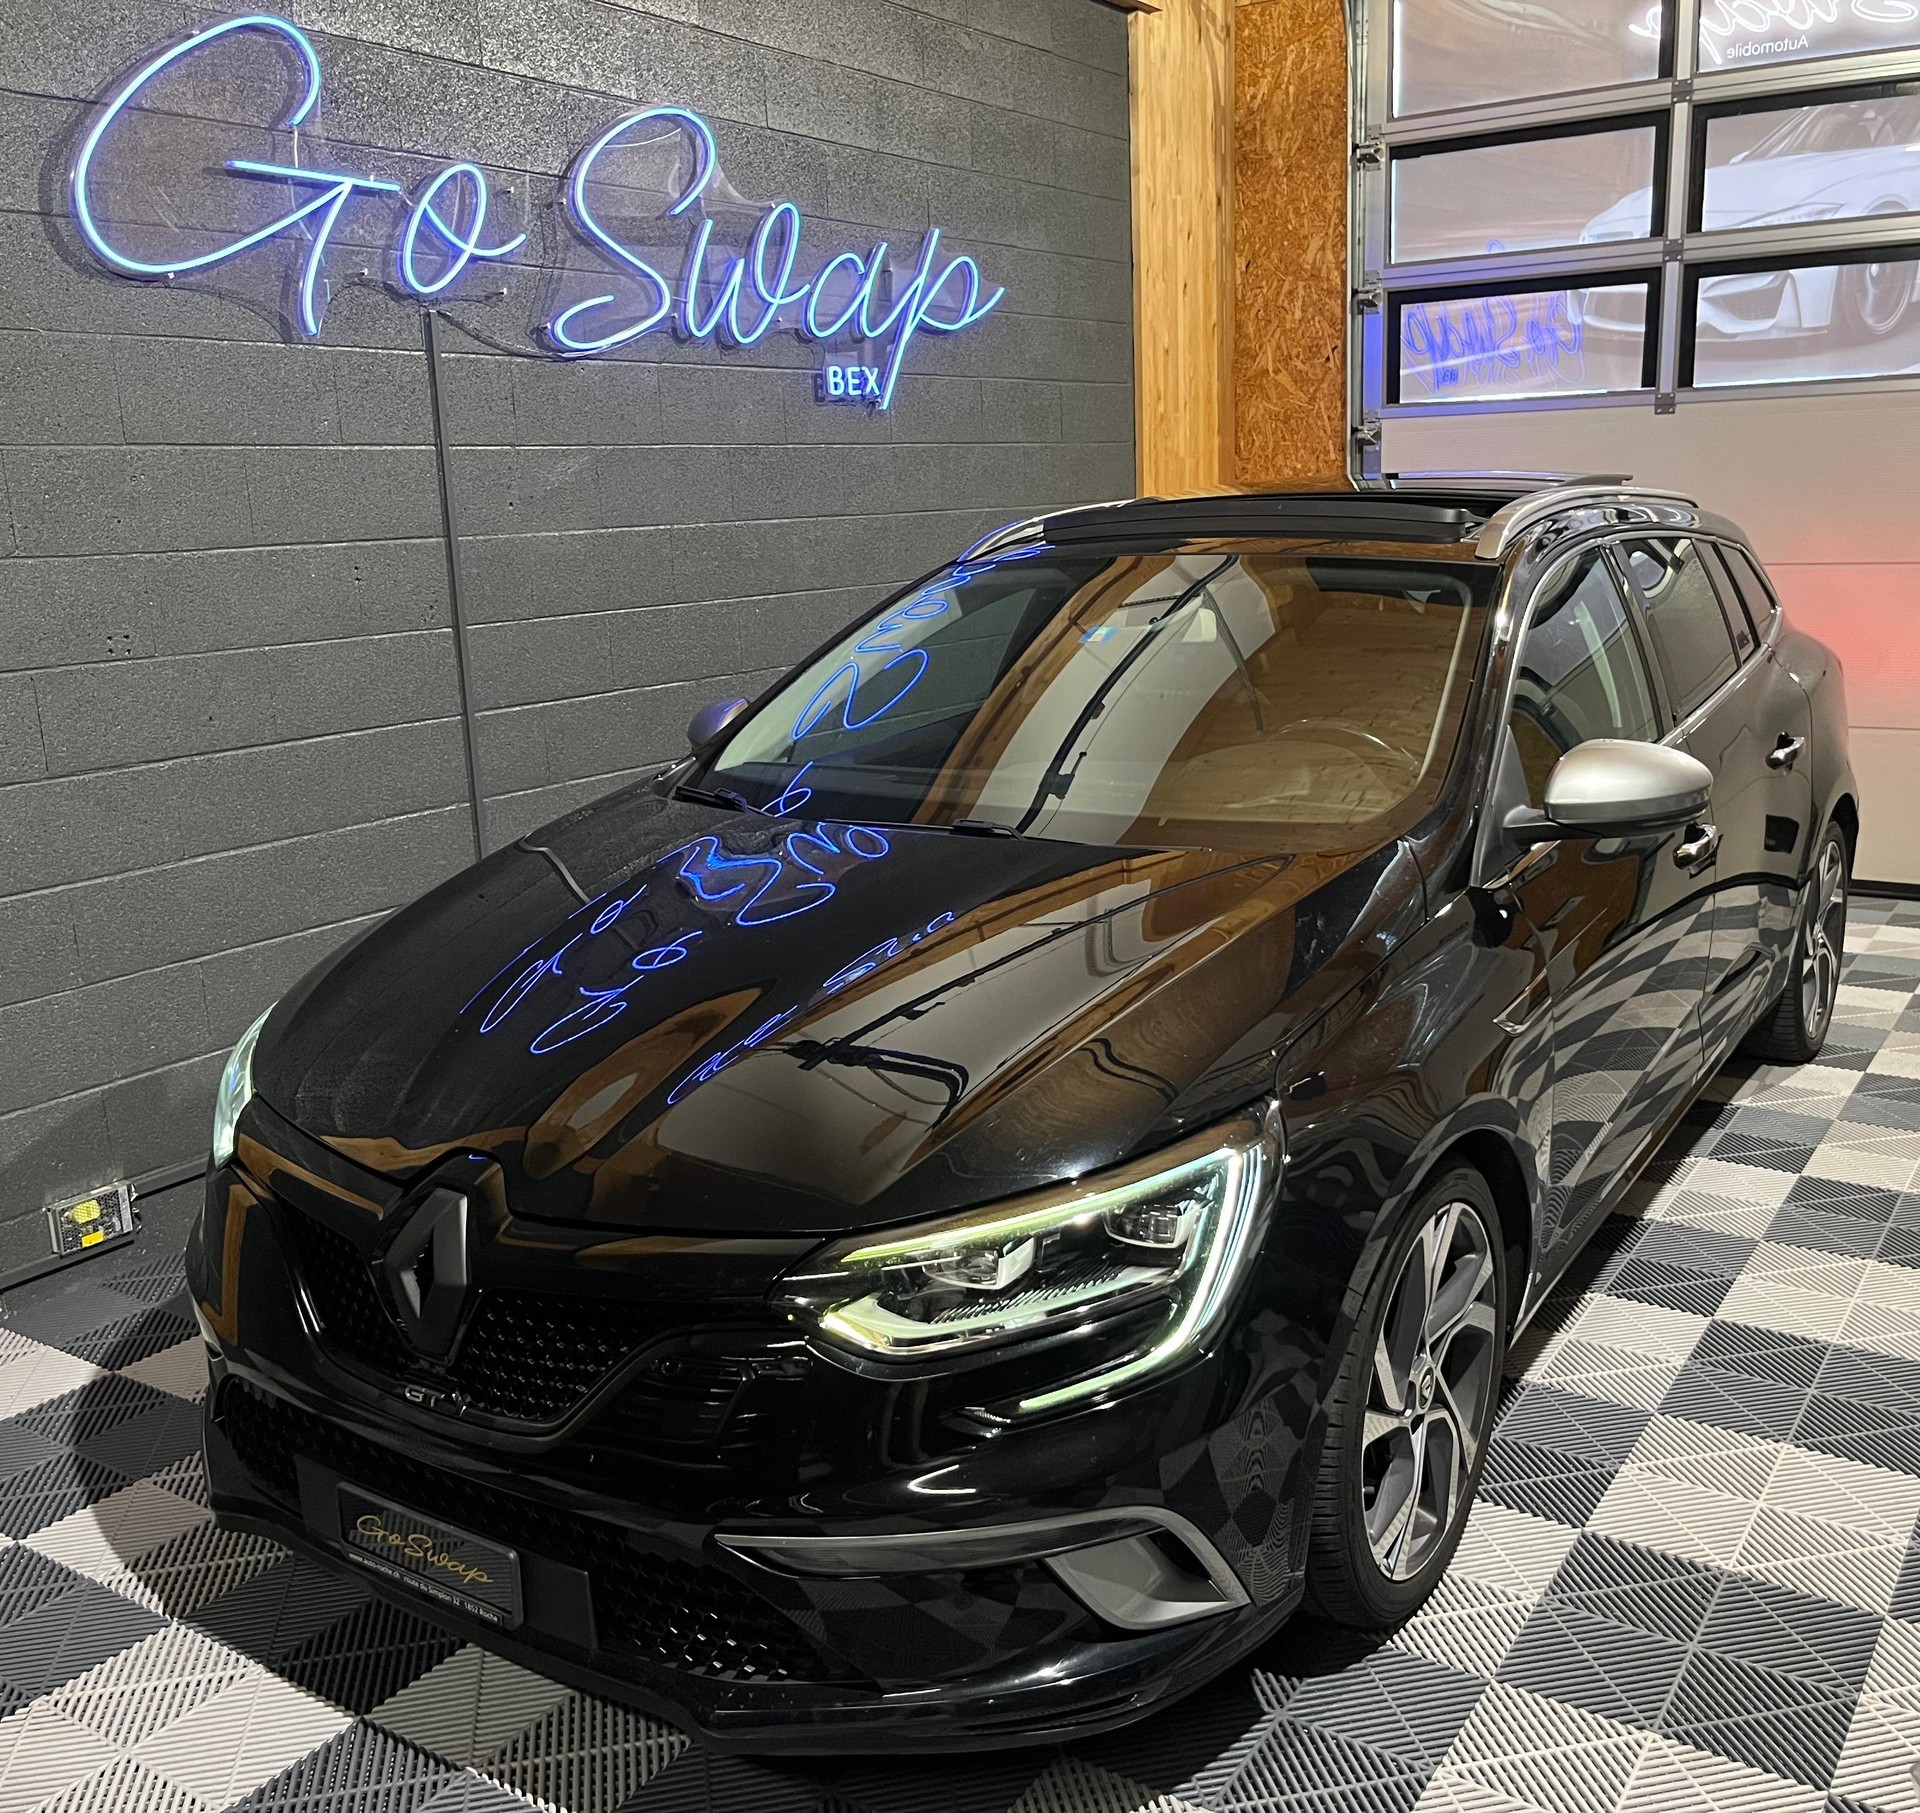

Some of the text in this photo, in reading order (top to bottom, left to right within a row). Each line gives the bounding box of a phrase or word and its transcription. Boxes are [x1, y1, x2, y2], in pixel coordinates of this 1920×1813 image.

[76, 15, 1006, 411] Go Swap
[825, 365, 881, 396] BEX
[404, 1384, 446, 1408] GT
